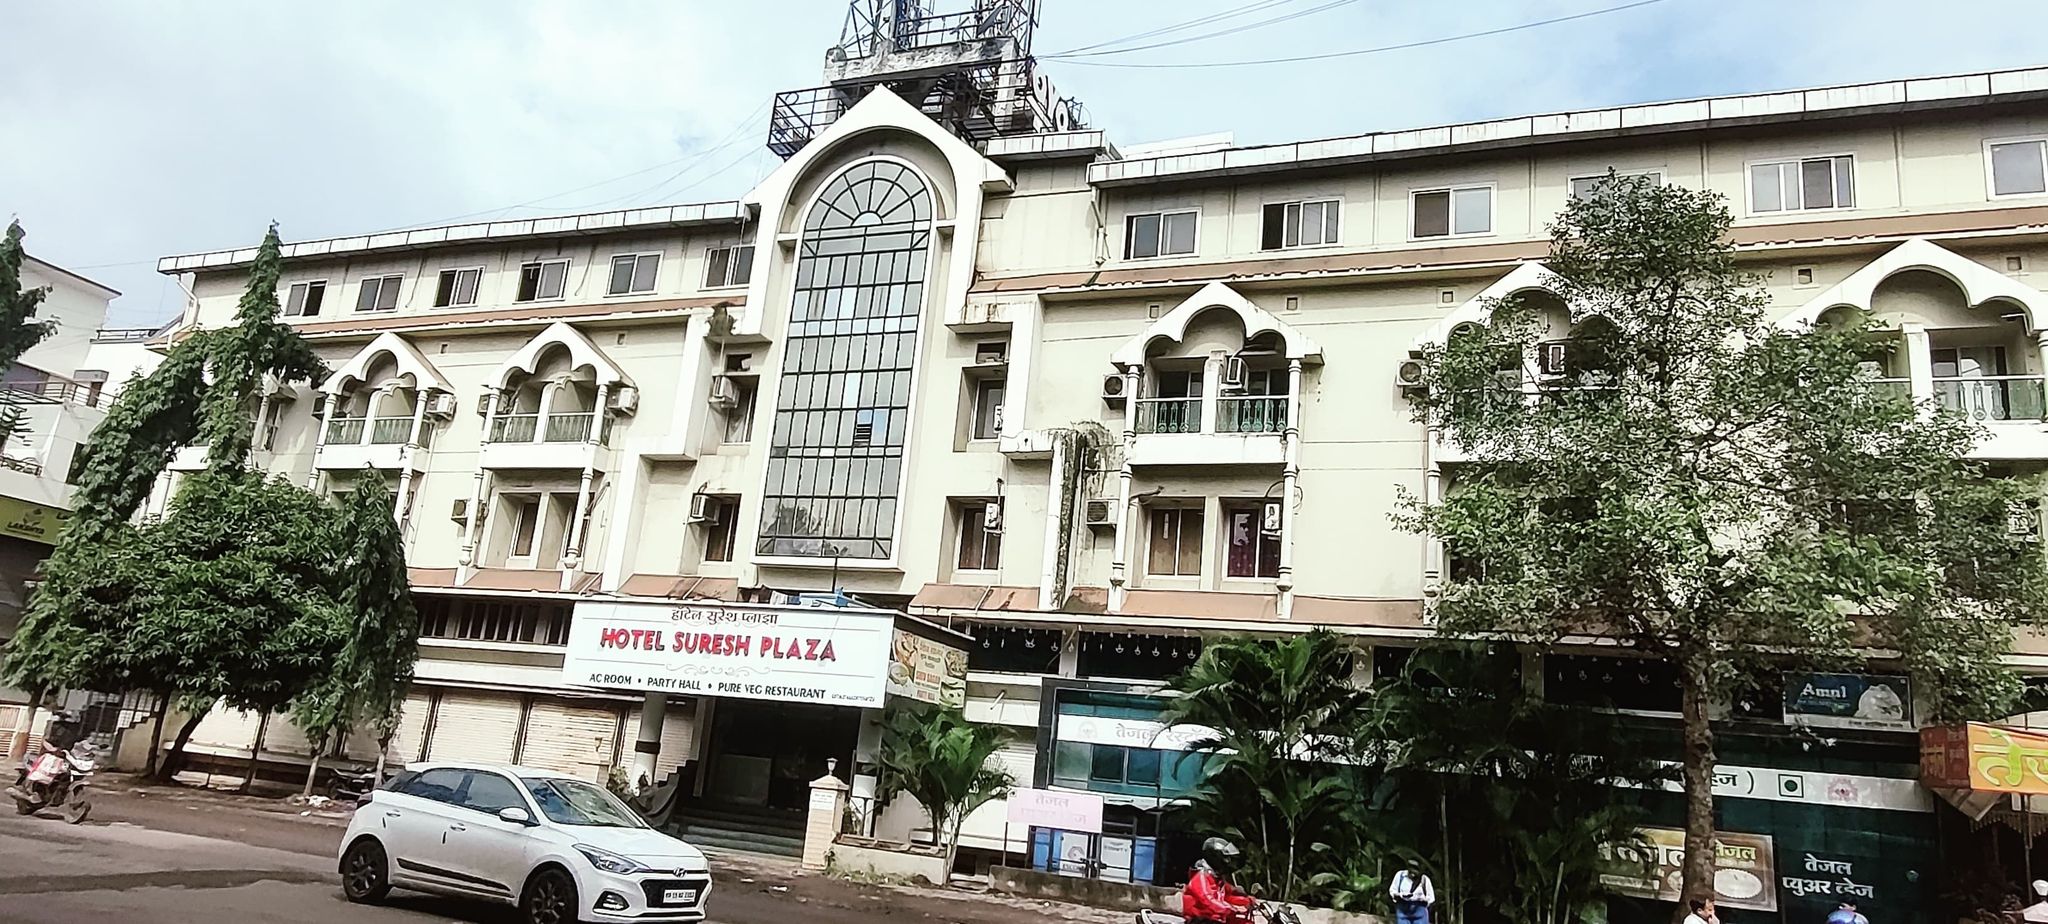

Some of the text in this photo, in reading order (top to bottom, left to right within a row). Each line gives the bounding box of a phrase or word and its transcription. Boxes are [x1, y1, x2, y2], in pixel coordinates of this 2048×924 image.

[671, 605, 780, 626] हॉटेल सुरेश प्लाझा
[600, 627, 836, 662] HOTEL SURESH PLAZA
[589, 673, 603, 684] AC
[604, 674, 632, 685] ROOM
[647, 676, 677, 689] PARTY
[678, 678, 702, 691] HALL
[717, 682, 742, 694] PURE
[744, 684, 763, 695] VEG
[764, 685, 826, 700] RESTAURANT
[1802, 682, 1847, 698] Amul
[1804, 853, 1853, 875] तेजल
[1782, 877, 1832, 897] प्युअर
